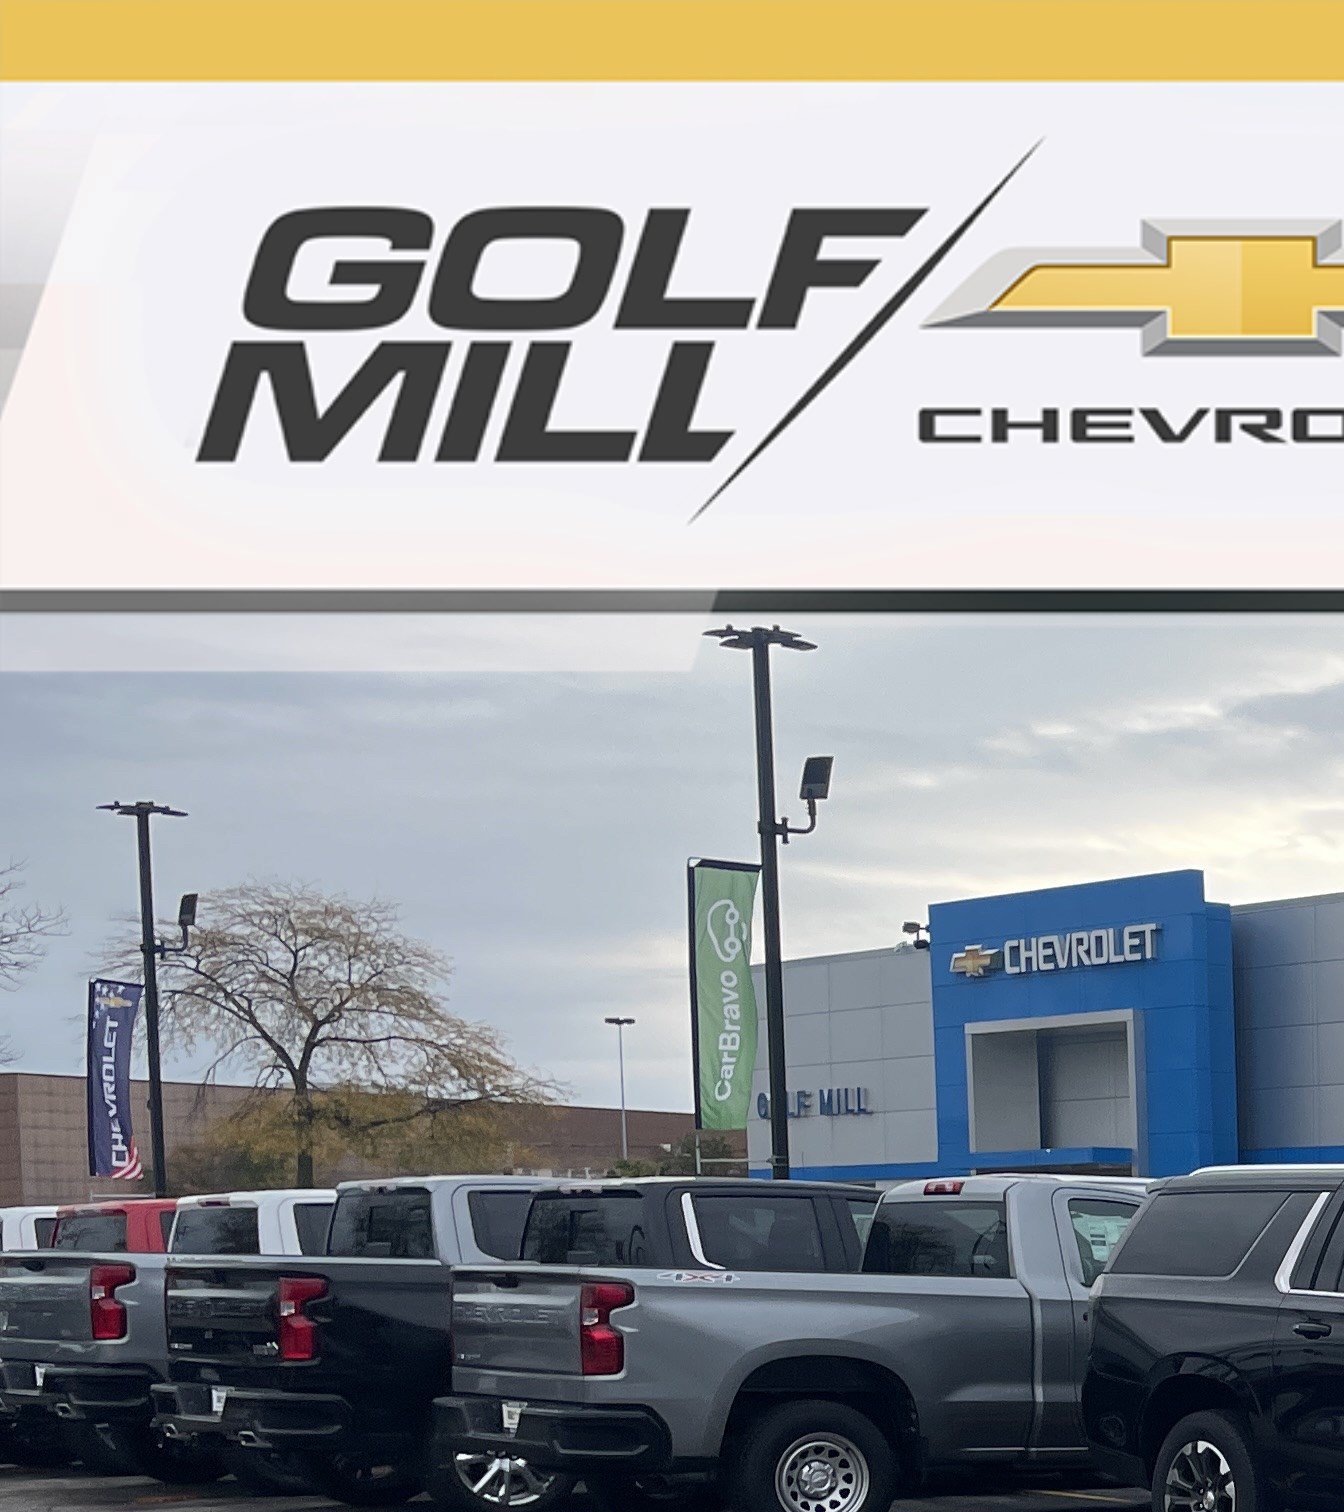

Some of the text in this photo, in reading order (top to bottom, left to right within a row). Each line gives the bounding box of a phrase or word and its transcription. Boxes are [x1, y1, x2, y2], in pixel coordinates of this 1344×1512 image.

[1004, 923, 1157, 975] CHEVROLET
[715, 970, 741, 1101] CarBravo
[102, 1015, 129, 1168] CHEVROLET
[757, 1087, 870, 1119] GLF MILL
